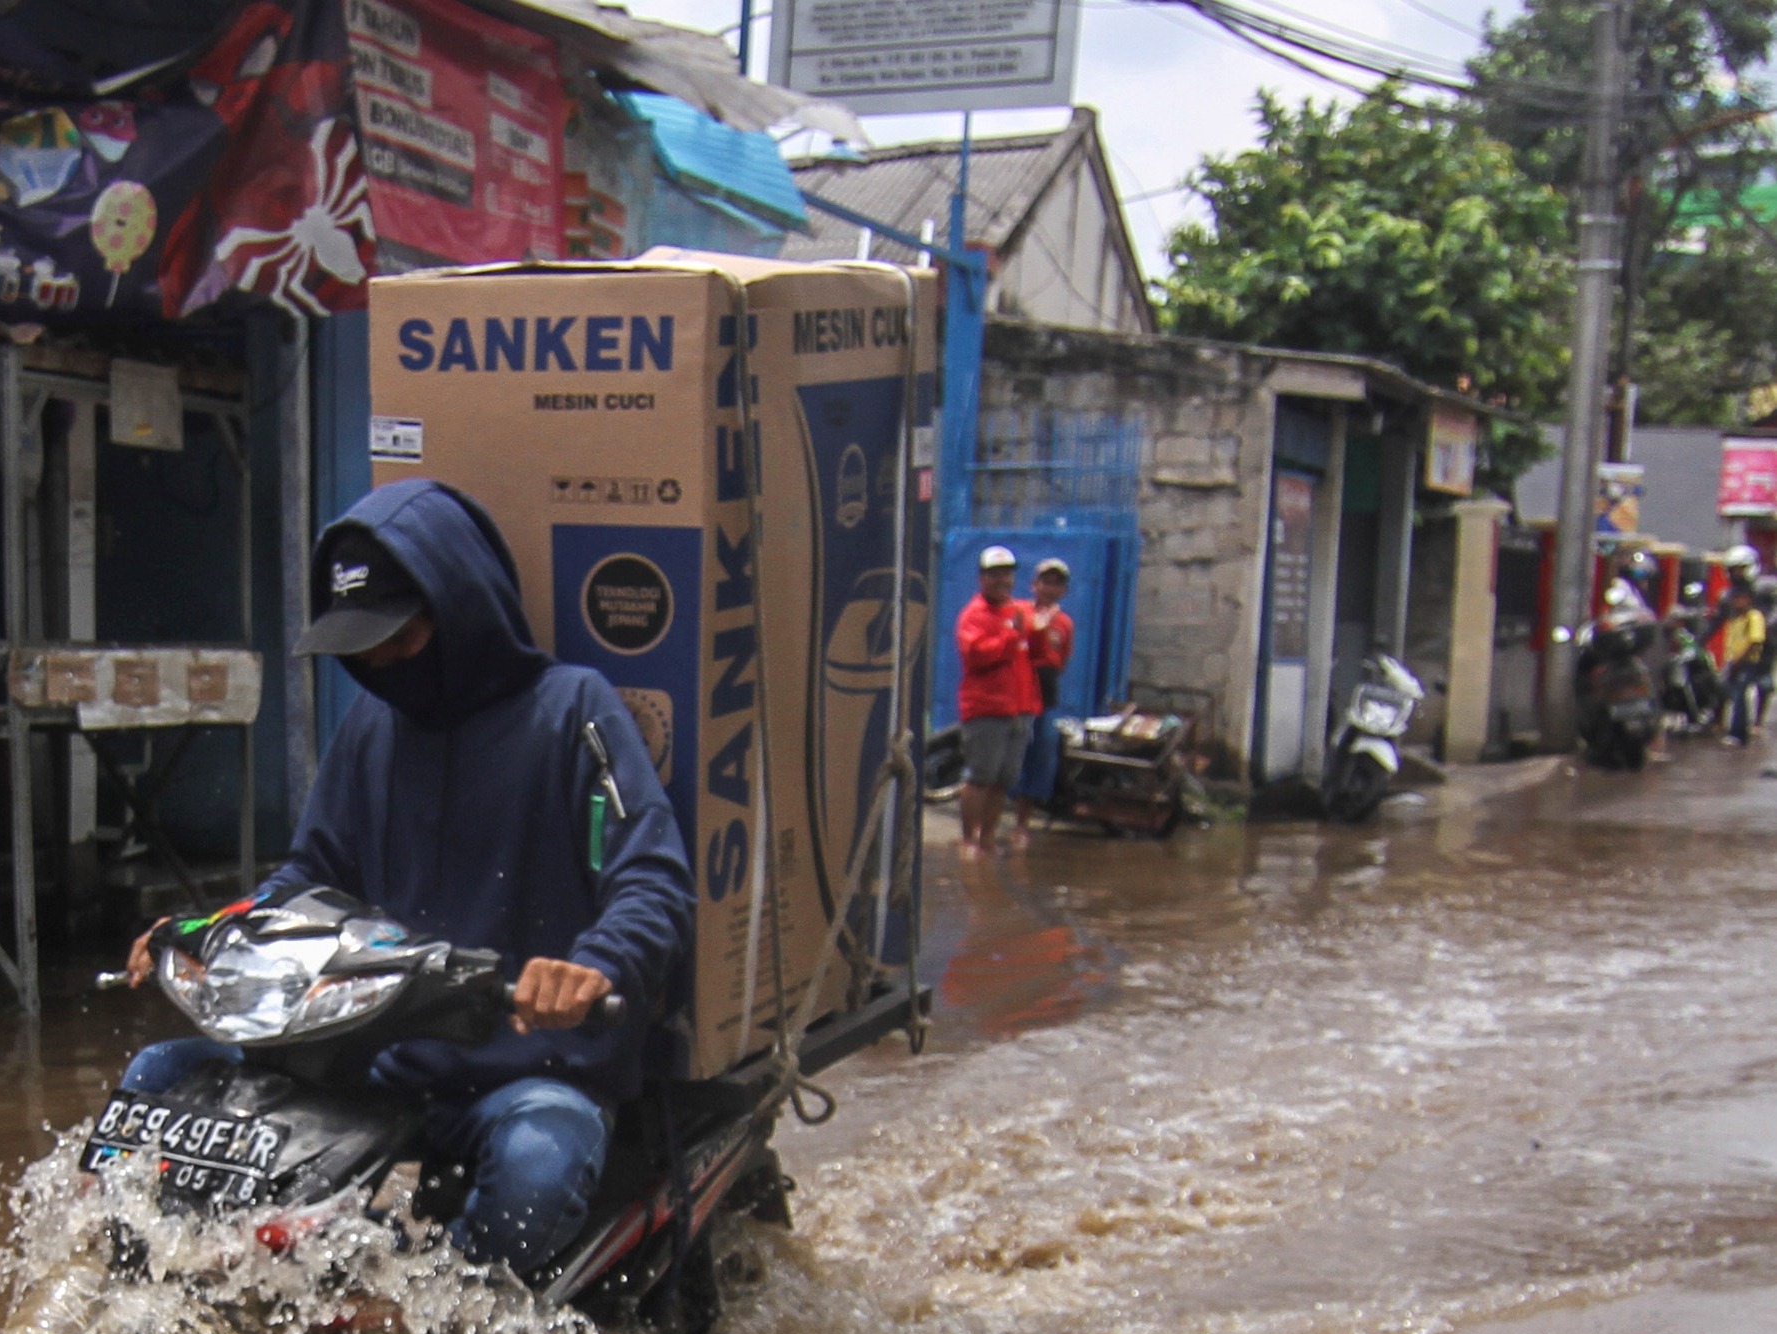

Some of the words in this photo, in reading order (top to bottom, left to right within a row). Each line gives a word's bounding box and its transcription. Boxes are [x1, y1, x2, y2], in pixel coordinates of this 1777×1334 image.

[398, 314, 675, 373] SANKEN
[793, 307, 866, 355] MESIN
[872, 306, 915, 348] CUC
[533, 393, 597, 410] MESIN
[604, 393, 655, 410] CUCI
